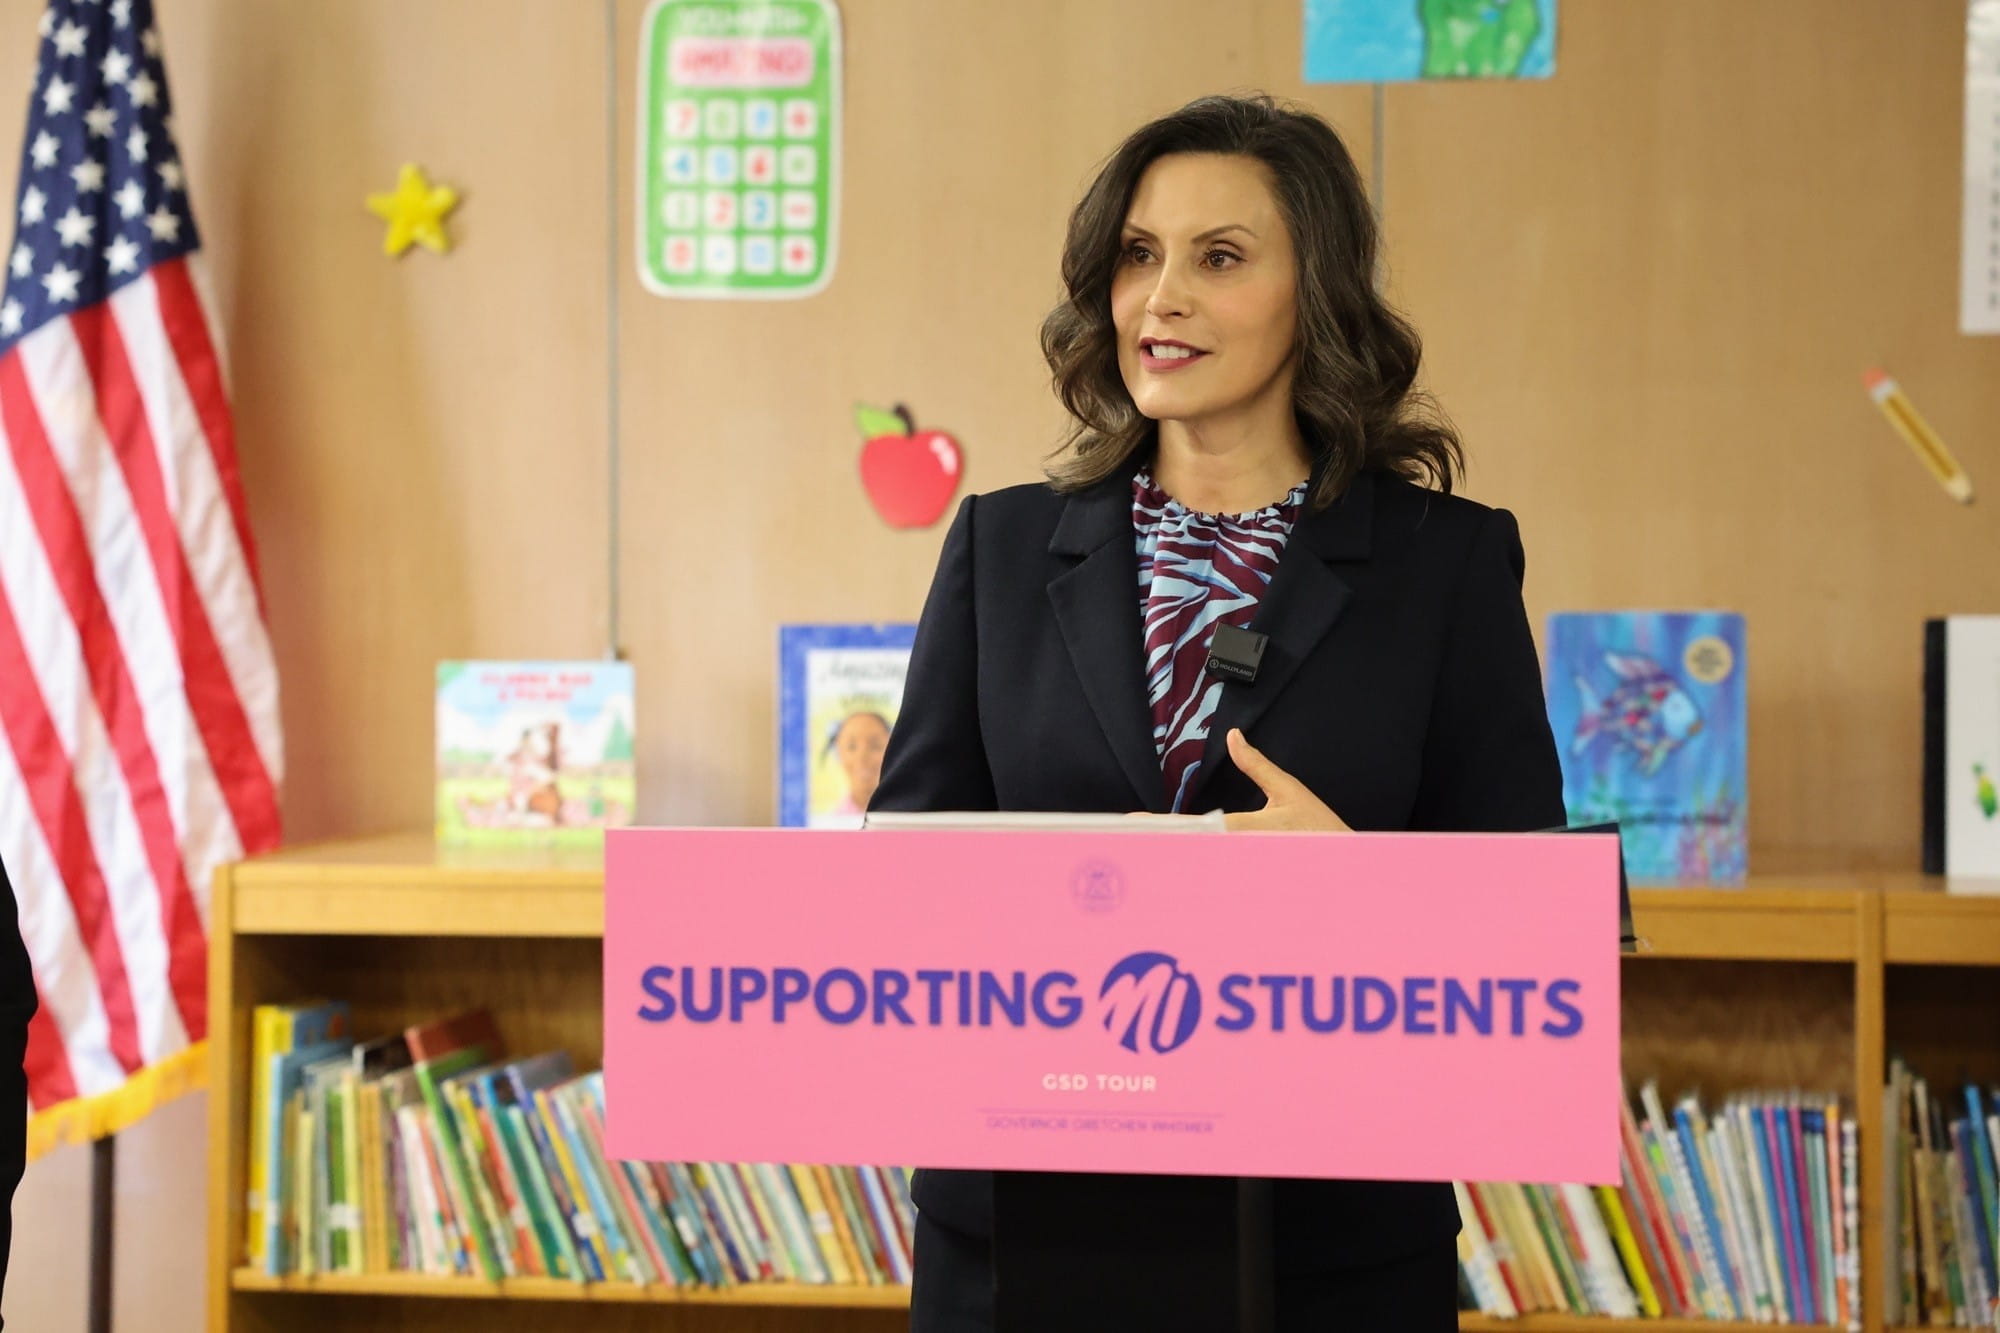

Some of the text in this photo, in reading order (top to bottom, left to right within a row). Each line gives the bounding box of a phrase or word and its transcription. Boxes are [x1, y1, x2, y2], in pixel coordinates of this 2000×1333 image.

[638, 965, 1084, 1029] SUPPORTING
[1215, 974, 1584, 1039] STUDENTS
[1042, 1073, 1157, 1092] GSD TOUR
[986, 1115, 1215, 1135] GOVERNOR GRETCHEN WHITMER
